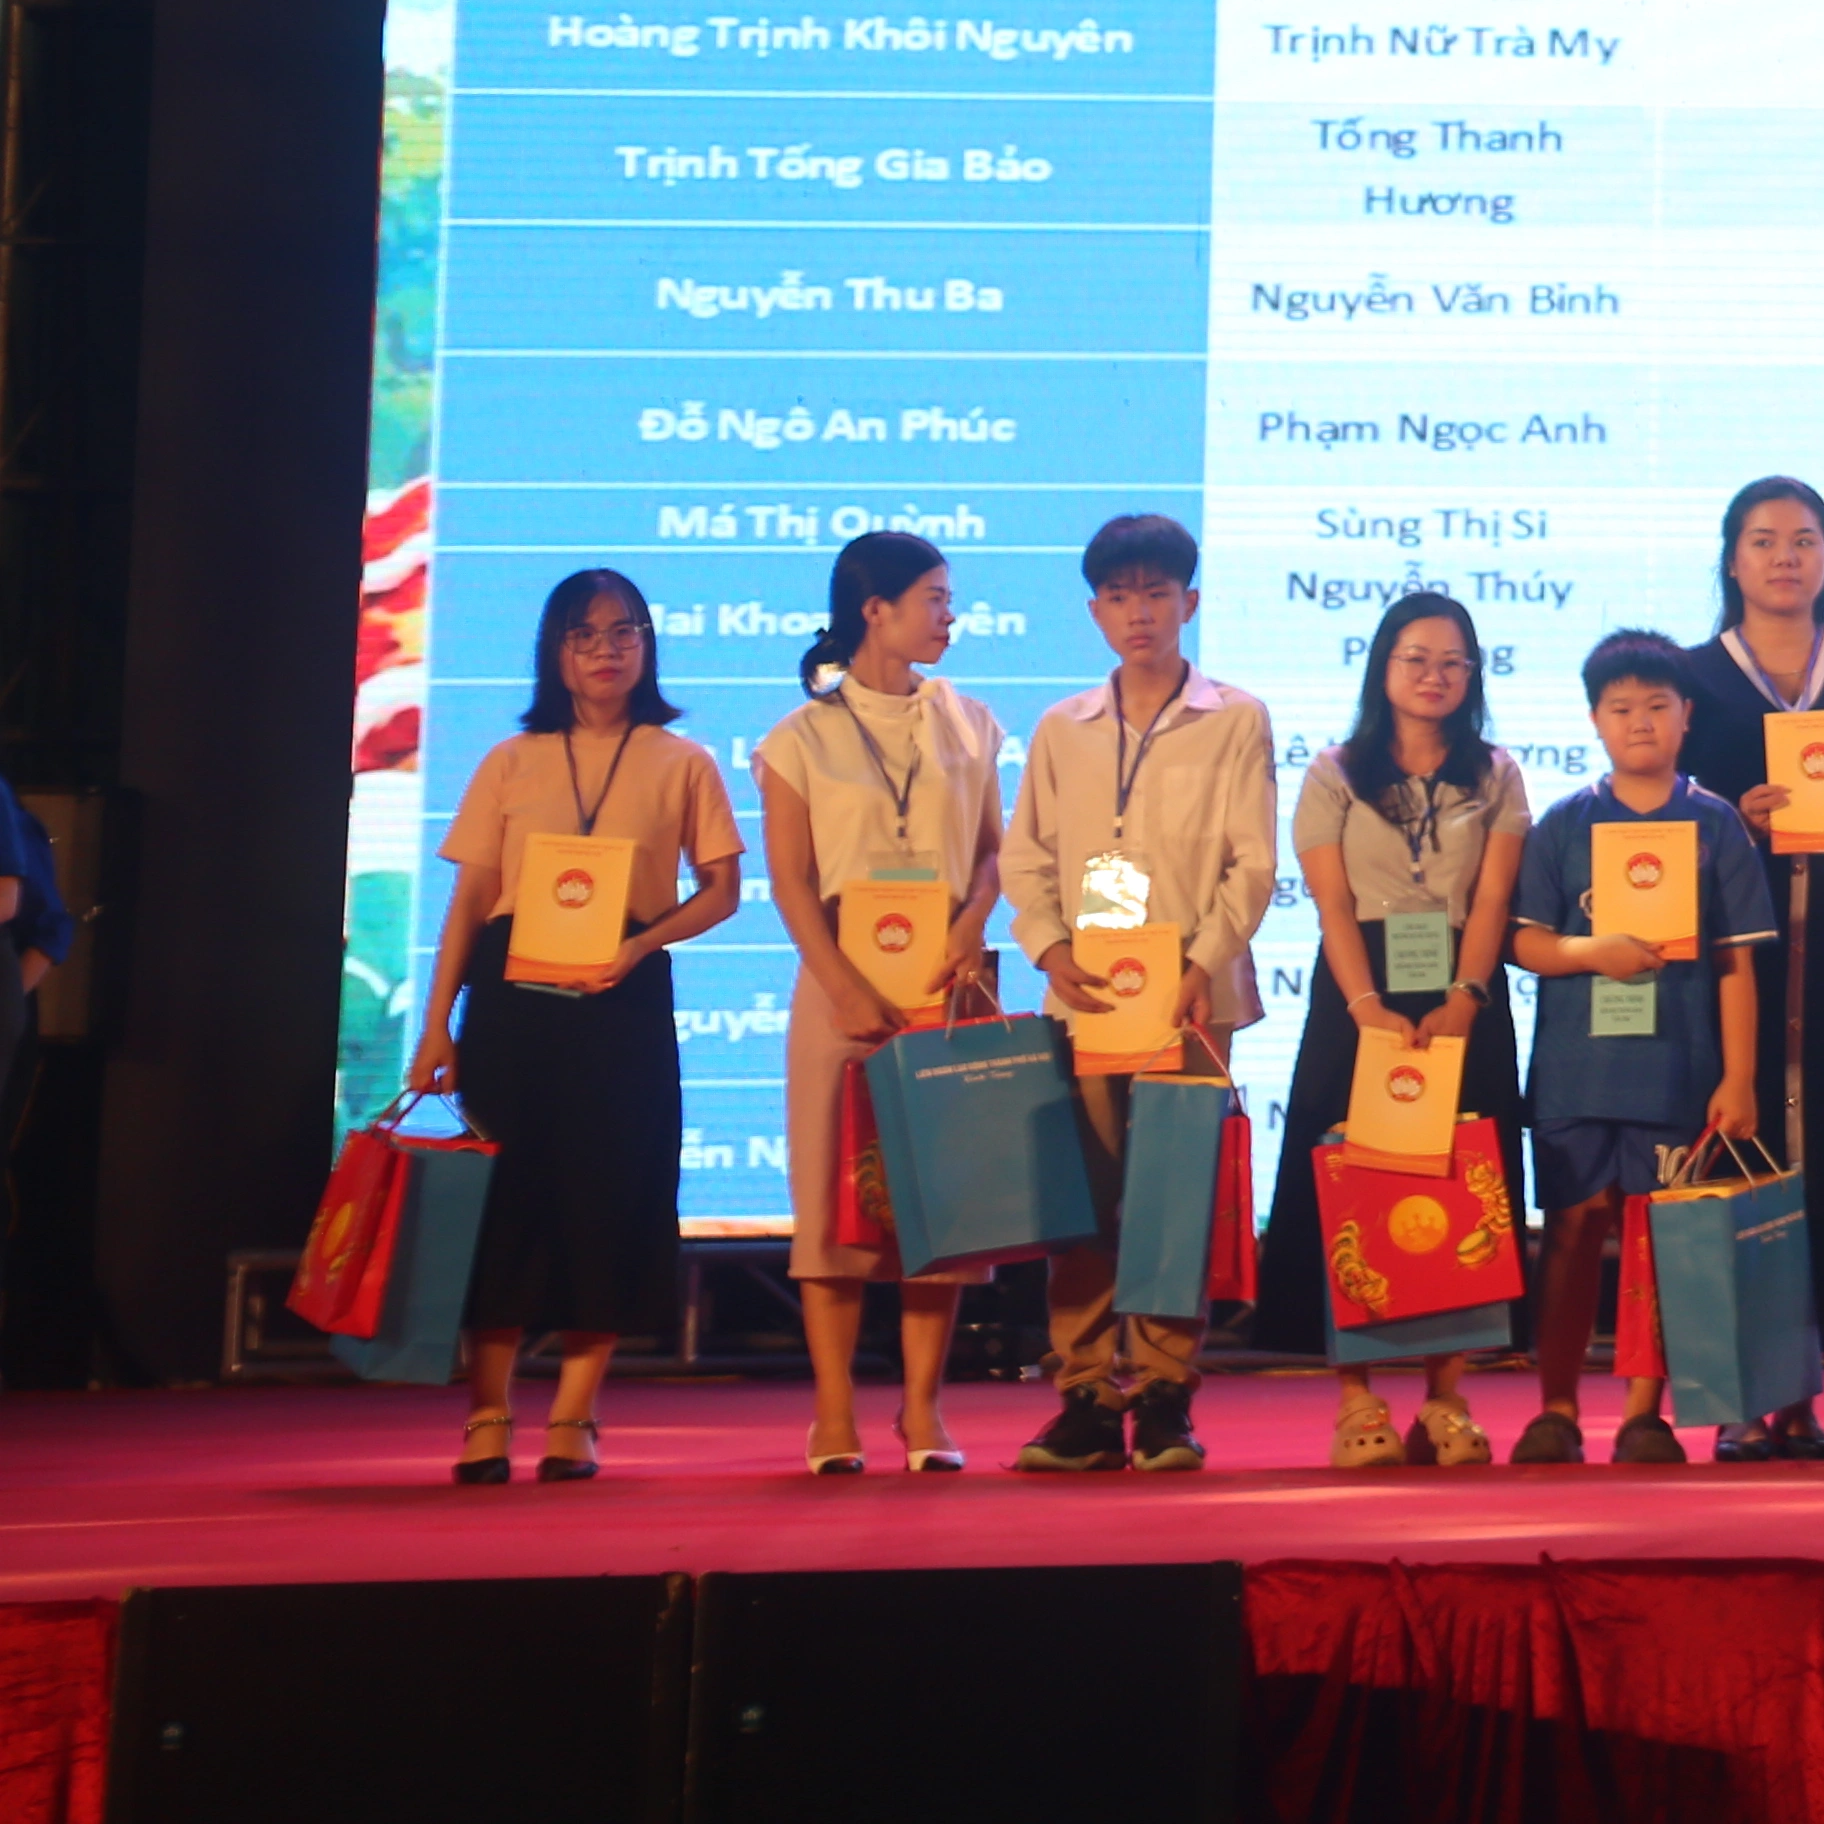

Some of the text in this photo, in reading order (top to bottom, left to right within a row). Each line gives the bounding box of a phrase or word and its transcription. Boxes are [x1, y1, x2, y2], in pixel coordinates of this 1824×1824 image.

[547, 12, 1135, 62] Hoàng Trịnh Khôi Nguyên
[1262, 22, 1621, 67] Trịnh Nữ Trà My
[614, 144, 740, 188] Trịnh
[745, 142, 865, 190] Tống
[873, 147, 951, 181] Gia
[655, 268, 1005, 320] Nguyễn Thu Ba
[636, 399, 1018, 450] Đỗ Ngô An Phúc
[1257, 409, 1608, 453] Phạm Ngọc Anh
